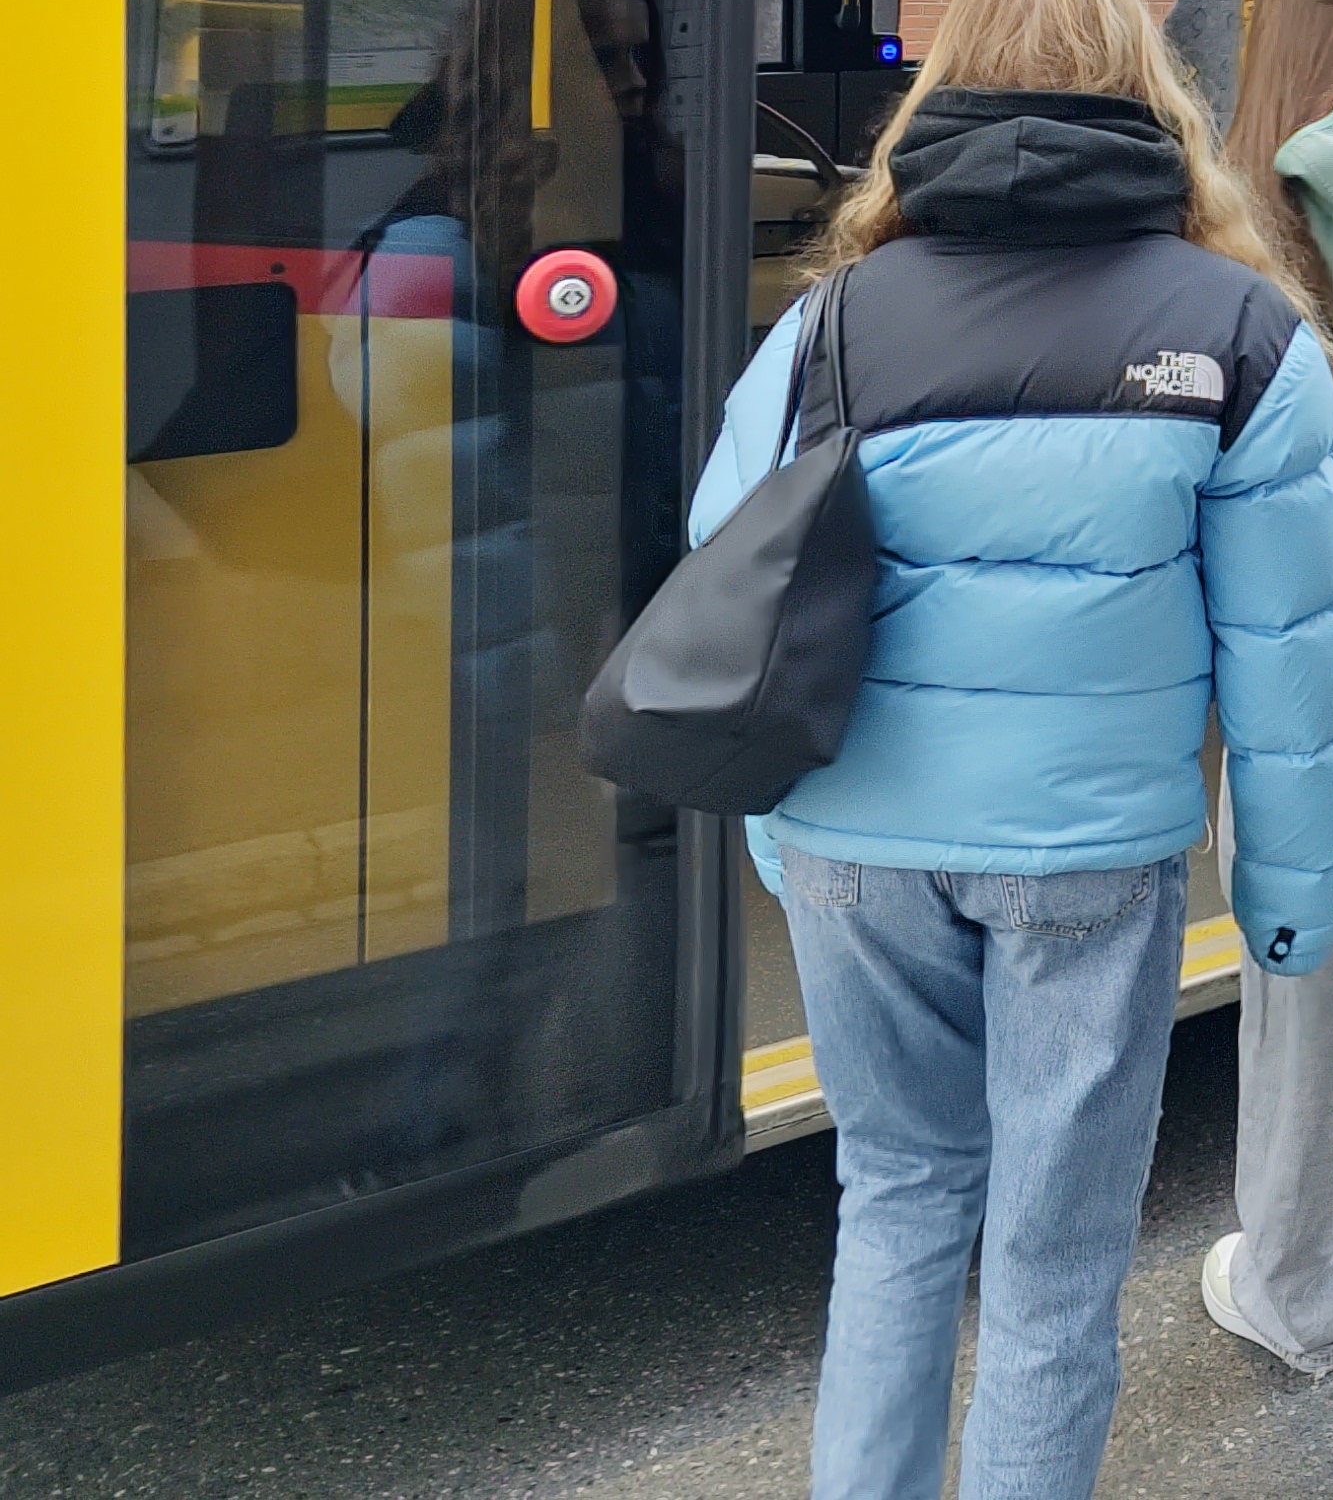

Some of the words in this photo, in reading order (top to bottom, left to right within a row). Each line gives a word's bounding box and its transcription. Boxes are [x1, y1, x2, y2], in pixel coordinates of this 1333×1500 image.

[1157, 350, 1197, 368] THE
[1125, 363, 1196, 382] NORTH
[1145, 379, 1195, 397] FACE
